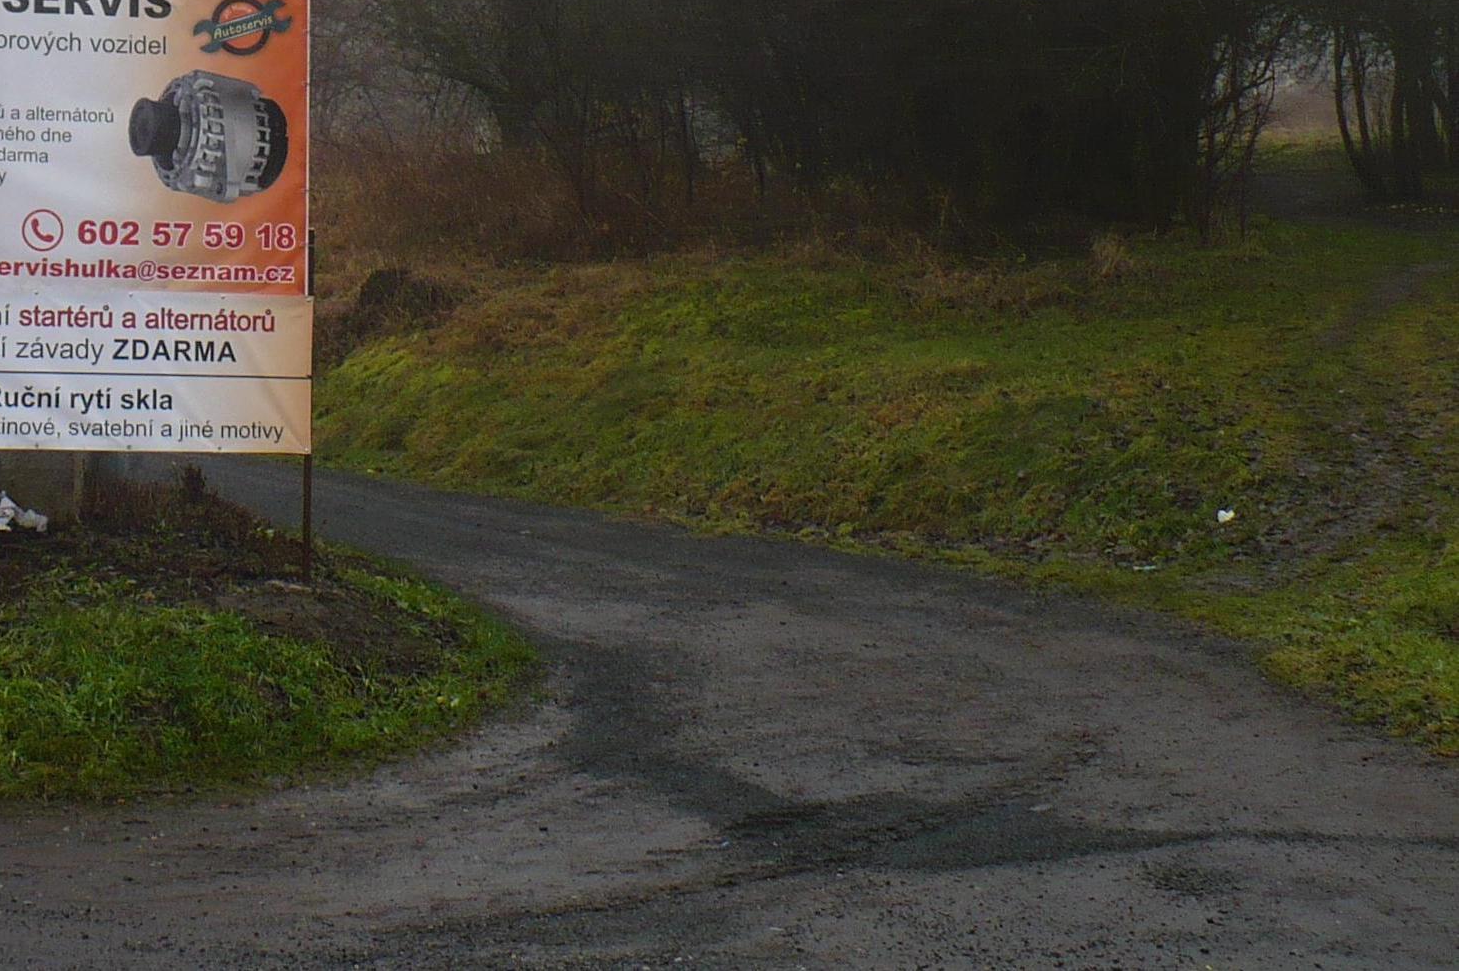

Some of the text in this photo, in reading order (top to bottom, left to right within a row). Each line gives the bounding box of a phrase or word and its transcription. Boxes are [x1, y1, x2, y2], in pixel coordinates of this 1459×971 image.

[213, 13, 274, 40] Autoservis
[91, 34, 167, 55] vozidel
[10, 108, 20, 120] a
[25, 106, 114, 123] alternátorů
[40, 127, 72, 143] dne
[77, 220, 295, 251] 602 57 59 18
[18, 304, 114, 329] startérů
[121, 312, 137, 330] a
[144, 307, 275, 333] alternátorů
[15, 337, 104, 365] závady
[112, 339, 237, 362] ZDARMA
[69, 387, 112, 414] rytí
[121, 387, 173, 411] skla
[68, 418, 154, 438] svatební
[160, 424, 172, 439] a
[178, 419, 214, 443] jiné
[221, 419, 284, 442] motivy
